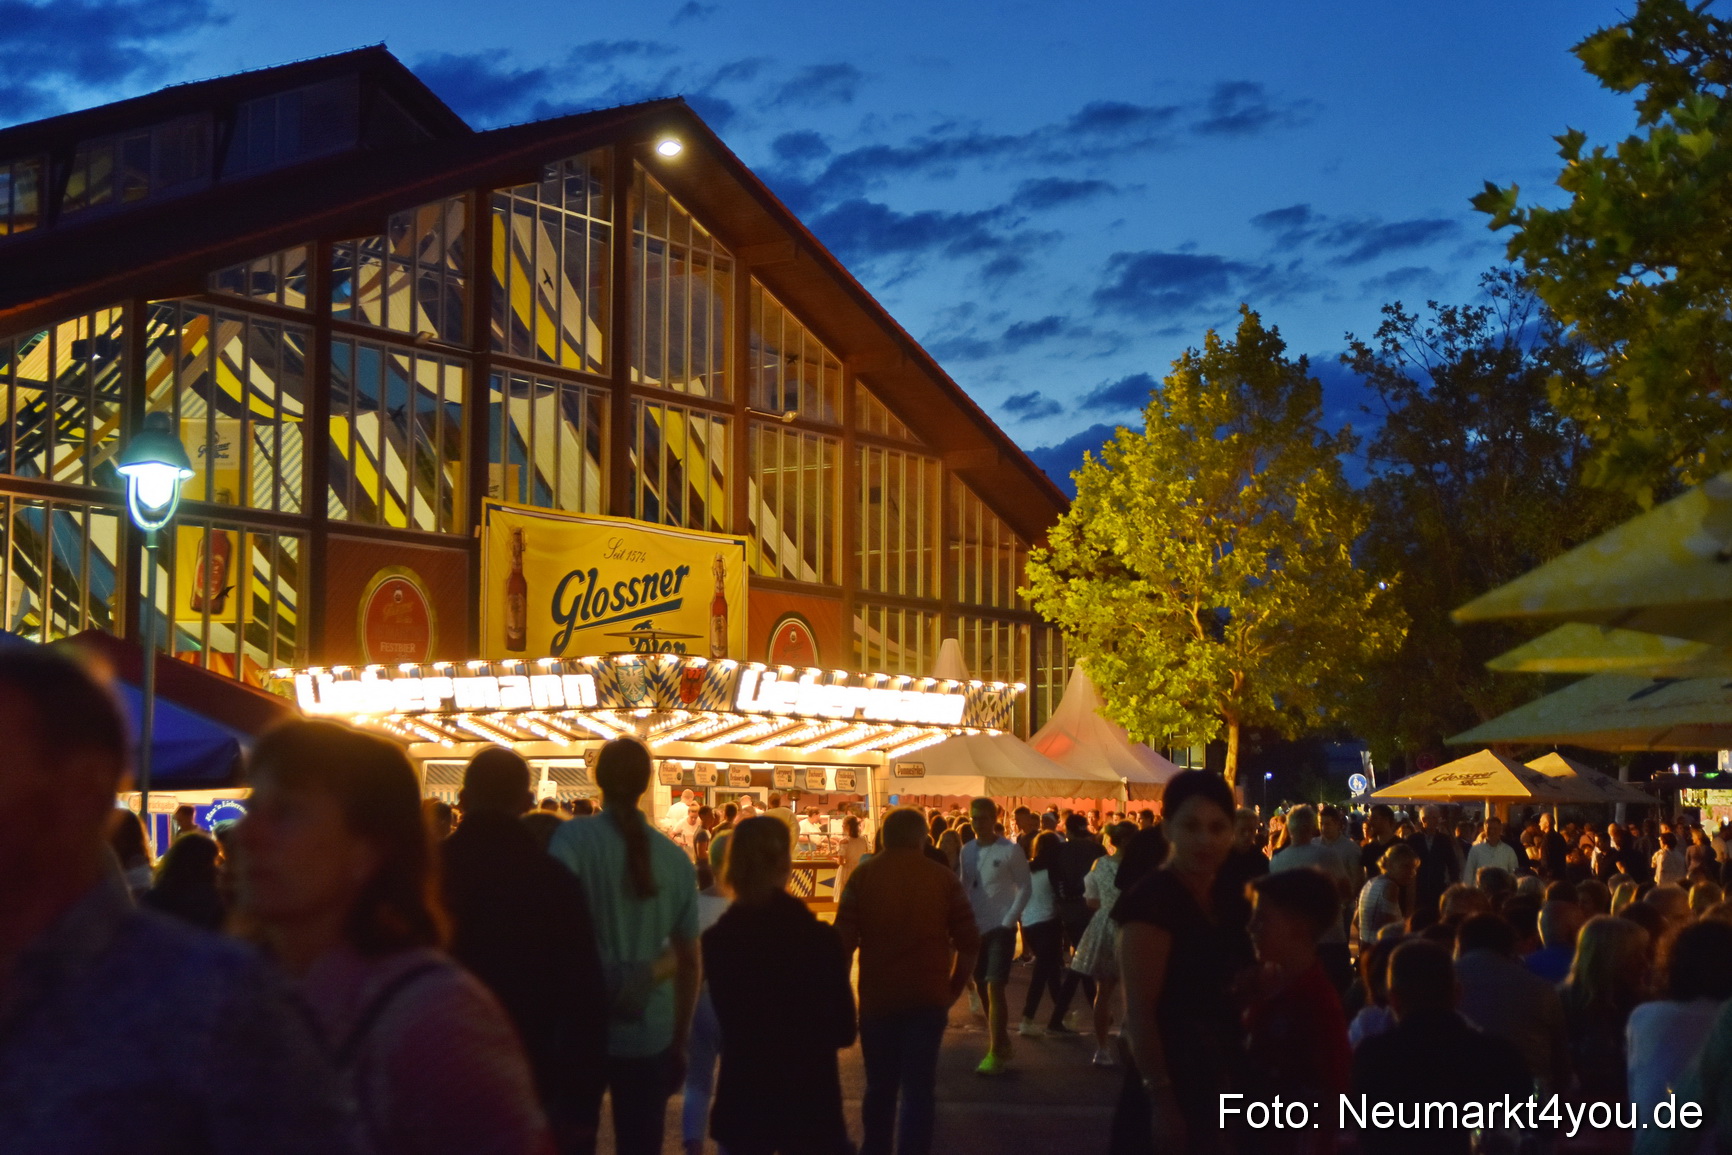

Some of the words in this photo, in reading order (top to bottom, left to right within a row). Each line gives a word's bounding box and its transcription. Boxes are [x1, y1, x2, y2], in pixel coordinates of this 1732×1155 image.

[603, 537, 626, 560] Seit
[625, 551, 647, 563] 1574
[550, 564, 690, 657] Glossner
[380, 642, 416, 653] FESTBIER
[296, 671, 598, 712] Liebermann
